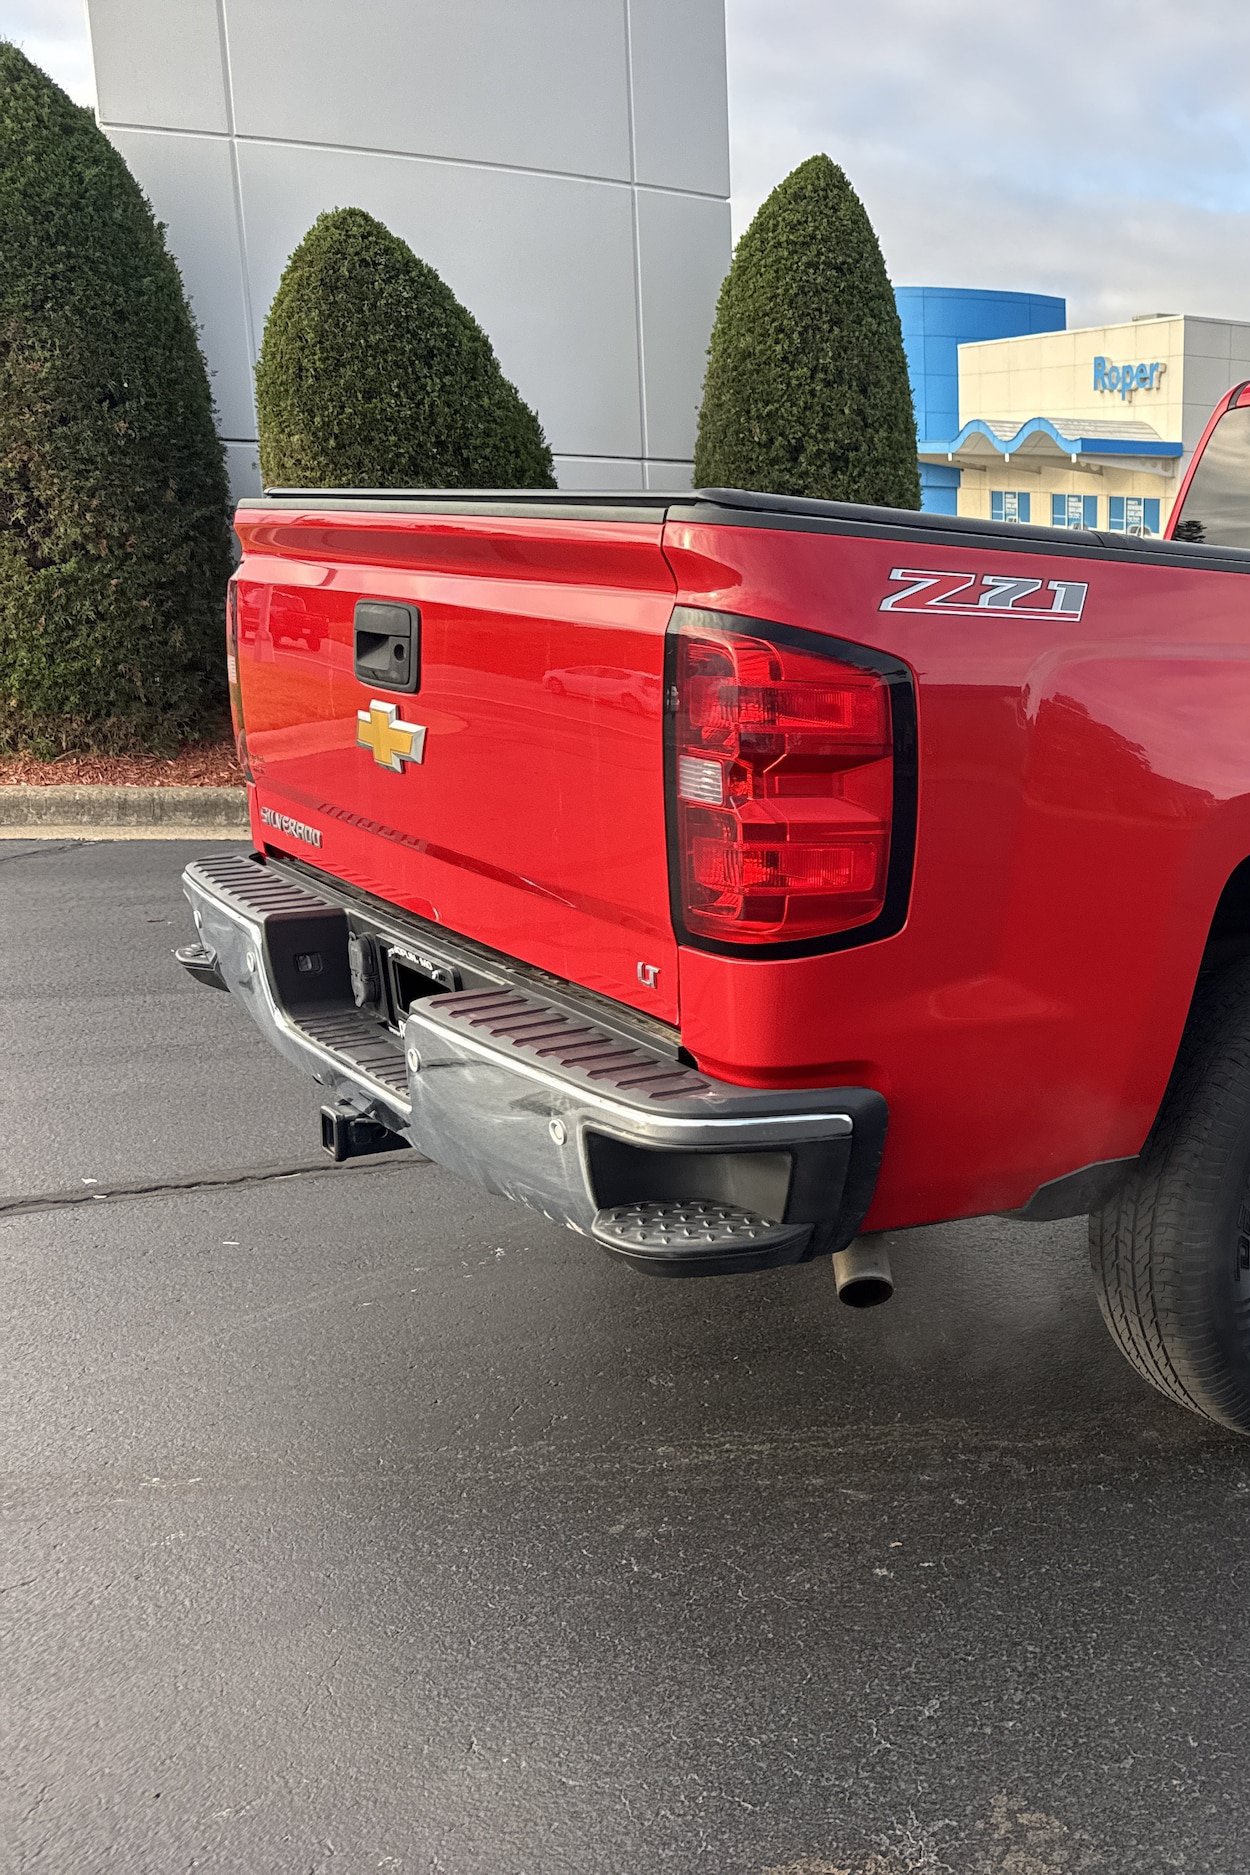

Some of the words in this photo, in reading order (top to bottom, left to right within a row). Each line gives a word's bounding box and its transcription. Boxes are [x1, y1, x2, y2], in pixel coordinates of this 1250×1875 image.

[1093, 355, 1166, 402] Roper
[878, 568, 1088, 622] Z71
[260, 806, 323, 849] SILVERADO
[637, 961, 661, 989] LT
